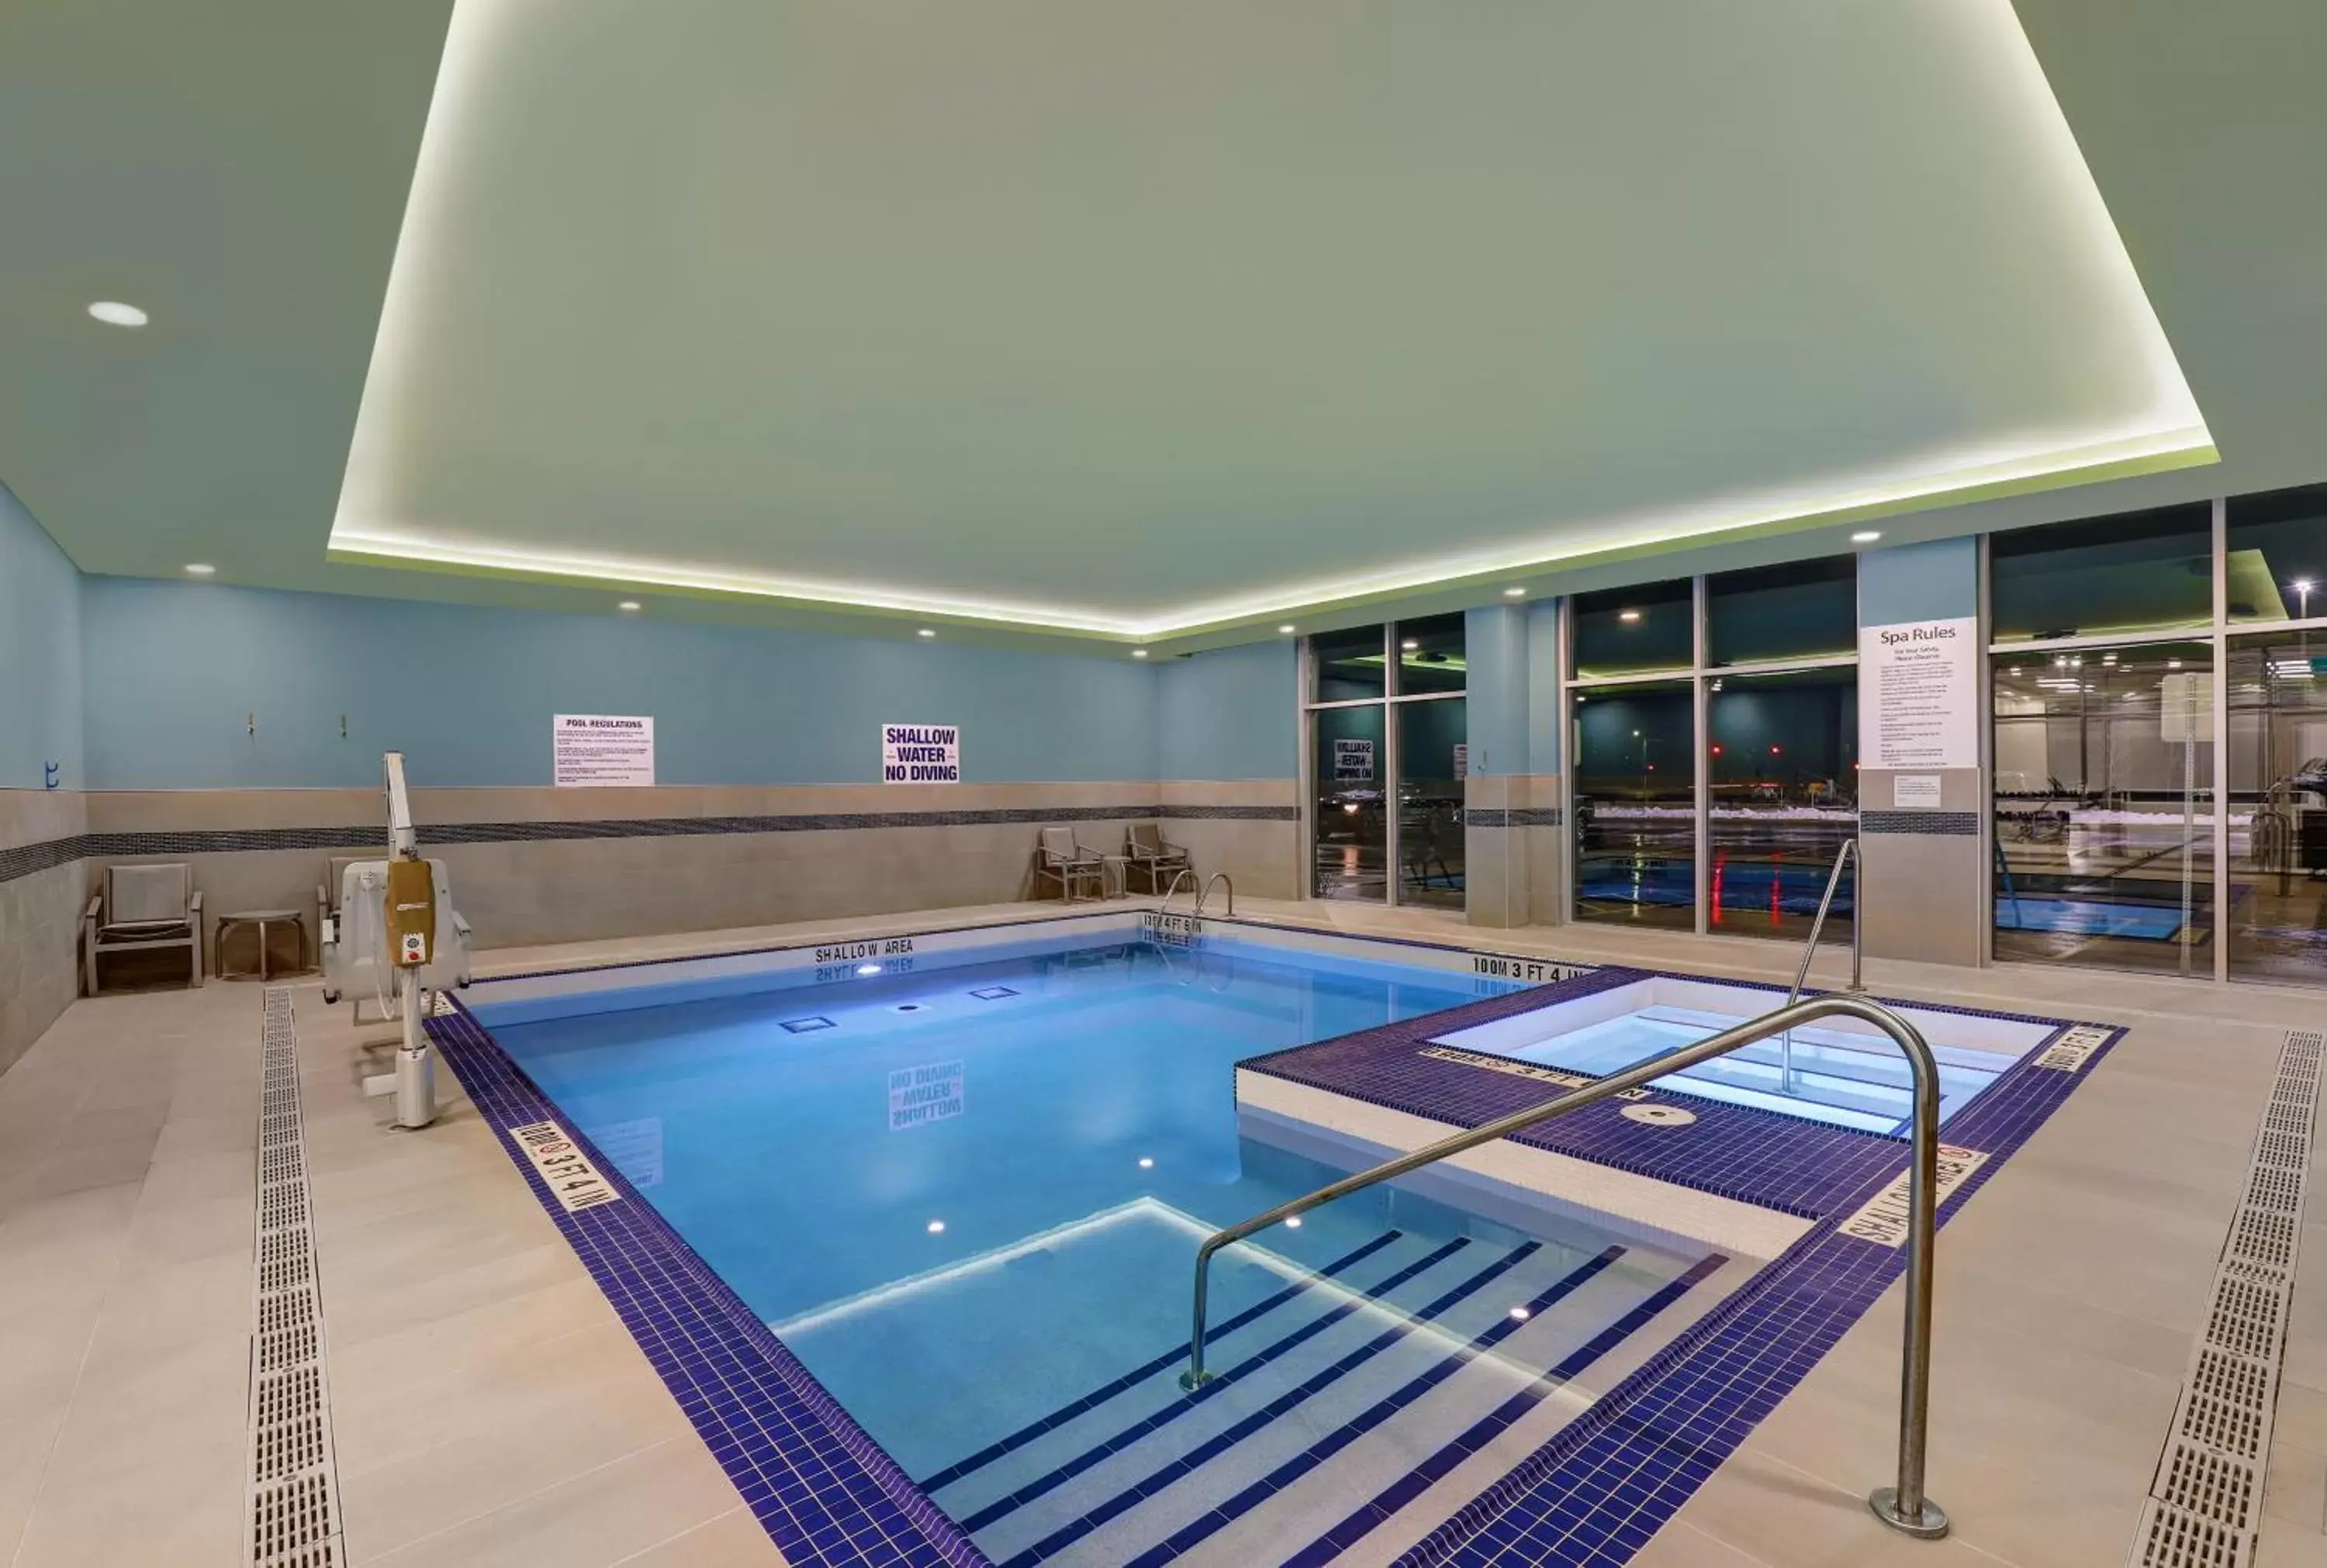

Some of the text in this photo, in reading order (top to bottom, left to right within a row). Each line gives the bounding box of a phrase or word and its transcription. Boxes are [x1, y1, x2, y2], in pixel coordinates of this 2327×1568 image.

[1880, 627, 1955, 645] Spa Rules
[566, 719, 643, 728] POOL REGULATIONS
[887, 727, 955, 744] SHALLOW
[897, 747, 946, 762] WATER
[885, 765, 957, 781] NO DIVING
[816, 939, 913, 962] SHALLOW AREA
[1513, 963, 1521, 978] 3
[1527, 965, 1544, 981] FT
[1551, 968, 1560, 983] 4
[543, 1155, 577, 1166] 3
[548, 1163, 590, 1179] FT
